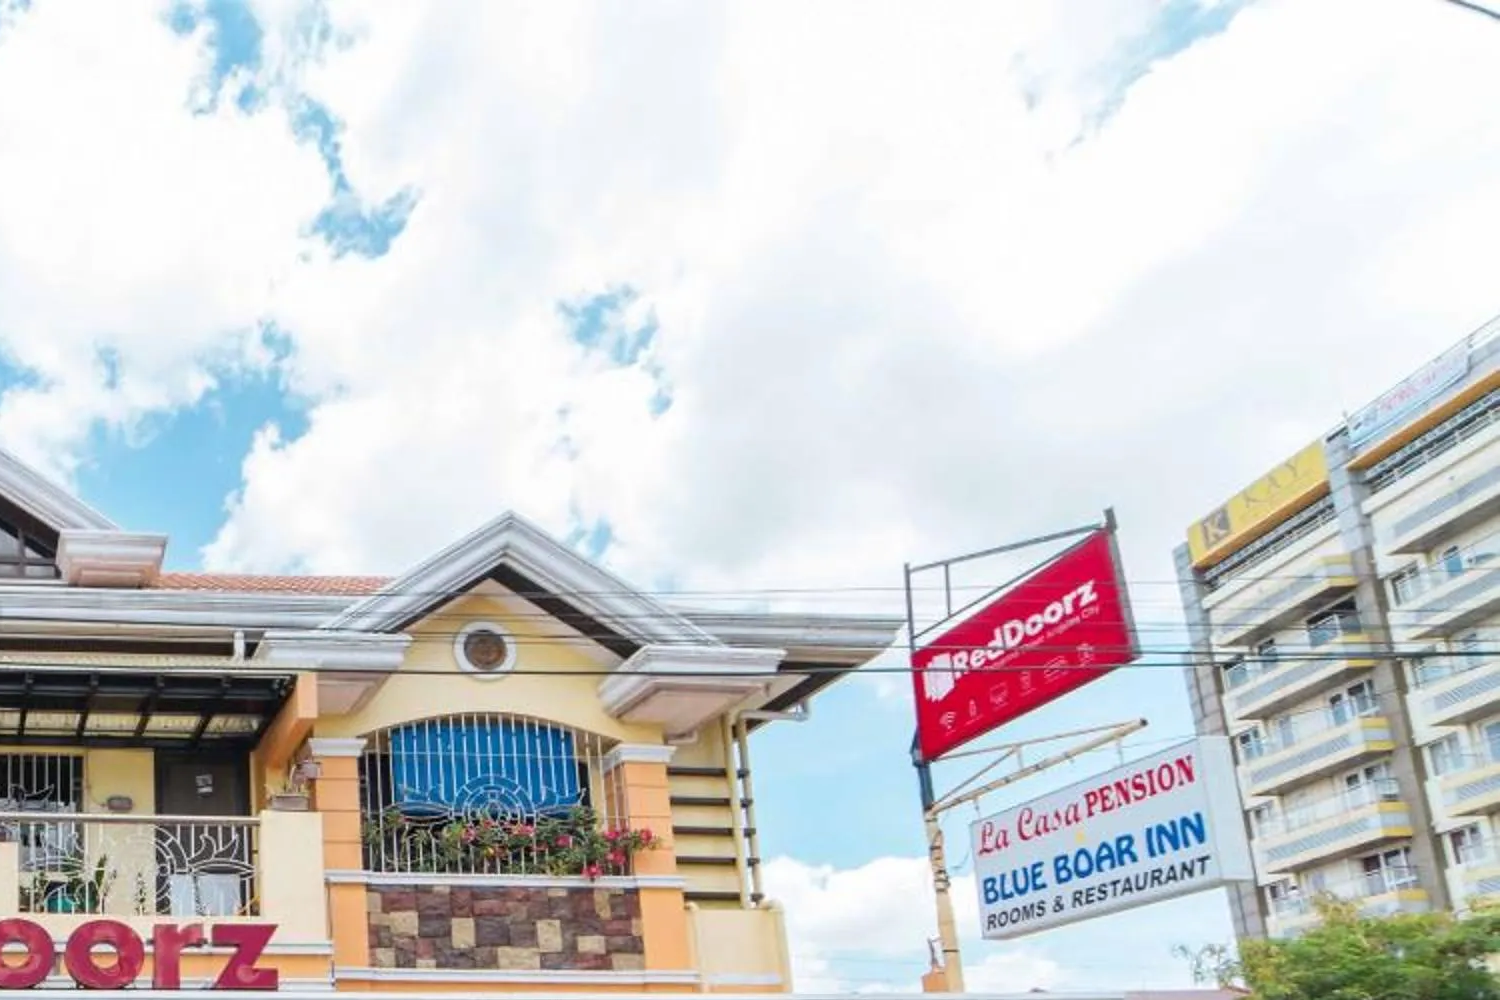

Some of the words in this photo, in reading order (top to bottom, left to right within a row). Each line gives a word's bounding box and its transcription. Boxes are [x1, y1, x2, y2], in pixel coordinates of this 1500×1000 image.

[952, 579, 1098, 679] RedDoorz
[979, 821, 1009, 856] La
[1017, 802, 1082, 842] Casa
[1084, 755, 1196, 818] PENSION
[982, 861, 1047, 905] BLUE
[1053, 833, 1139, 885] BOAR
[1145, 812, 1206, 858] INN
[986, 899, 1046, 931] ROOMS
[1052, 896, 1065, 913] &
[1071, 855, 1211, 909] RESTAURANT
